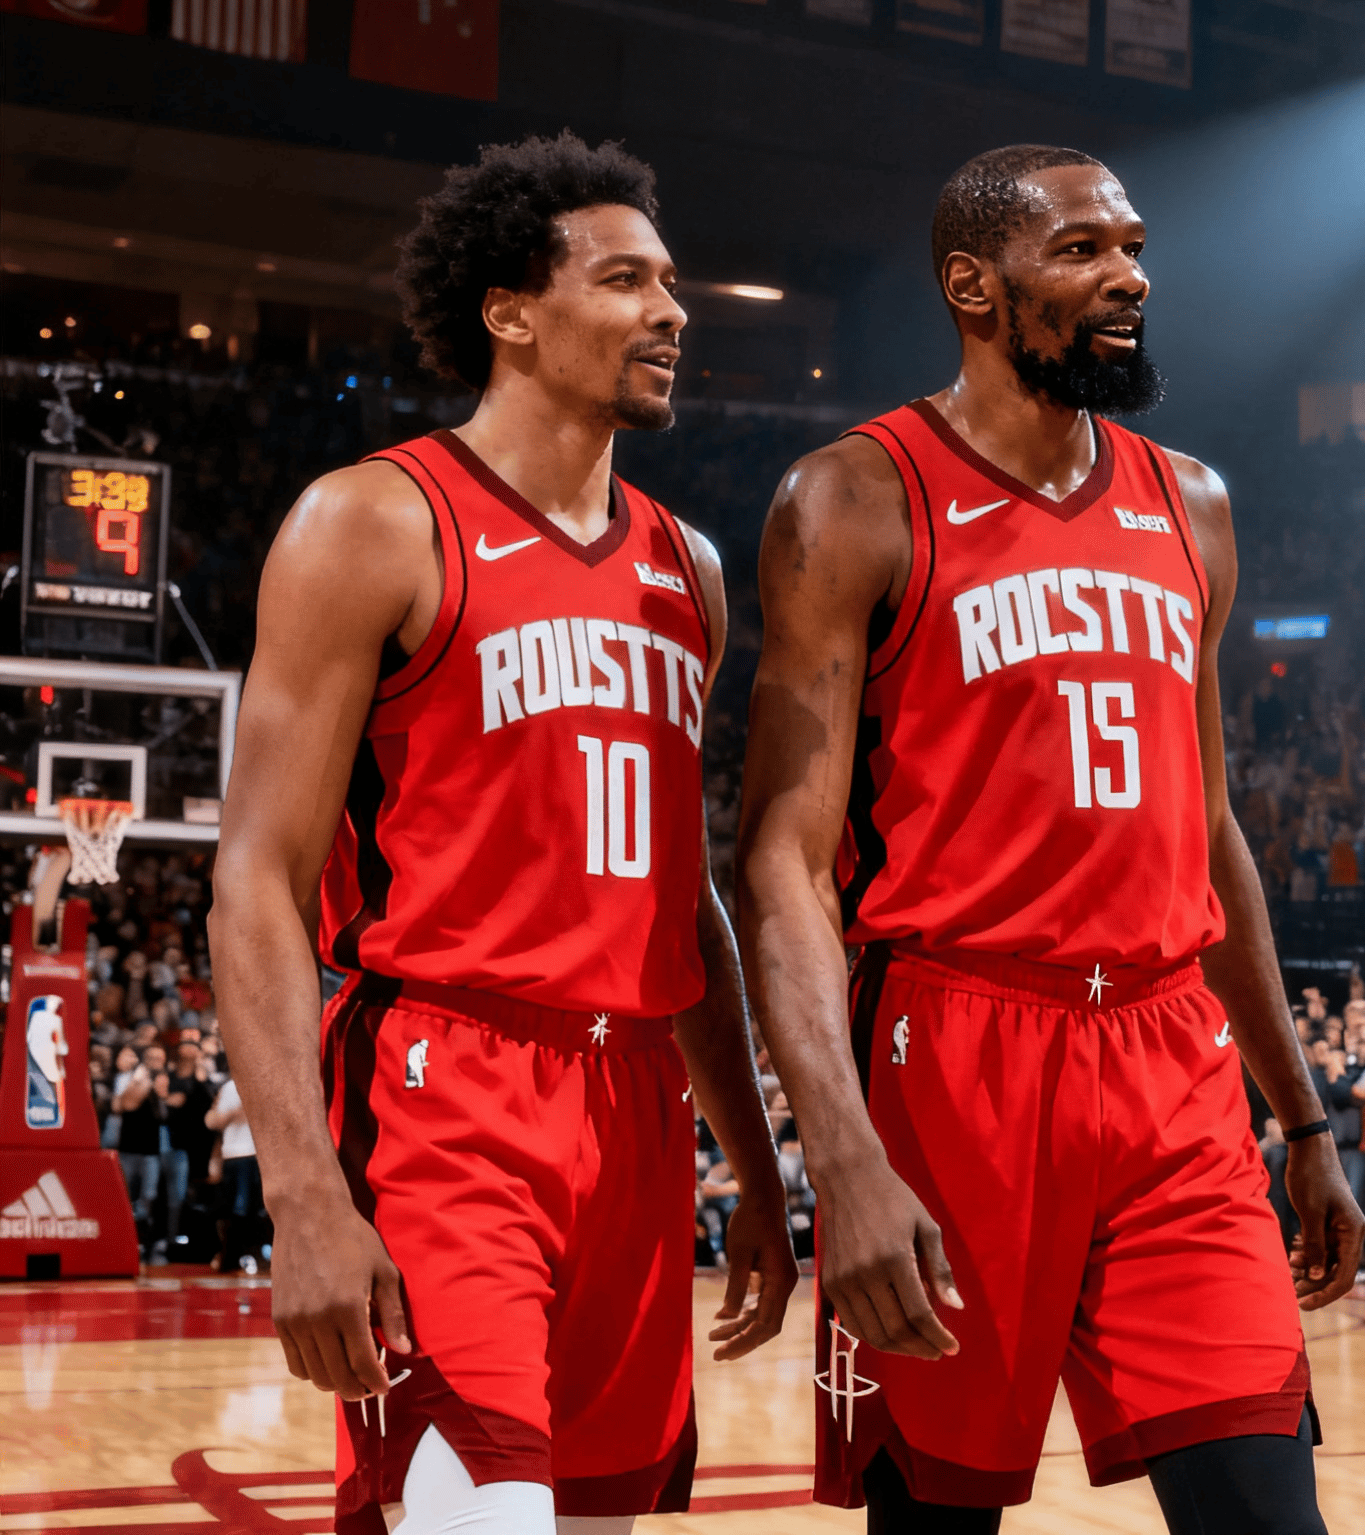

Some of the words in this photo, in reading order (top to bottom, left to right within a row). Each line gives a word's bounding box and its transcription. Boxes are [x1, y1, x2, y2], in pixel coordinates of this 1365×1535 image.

[953, 567, 1194, 686] ROCSTTS
[576, 734, 651, 879] 10
[1057, 679, 1142, 809] 15
